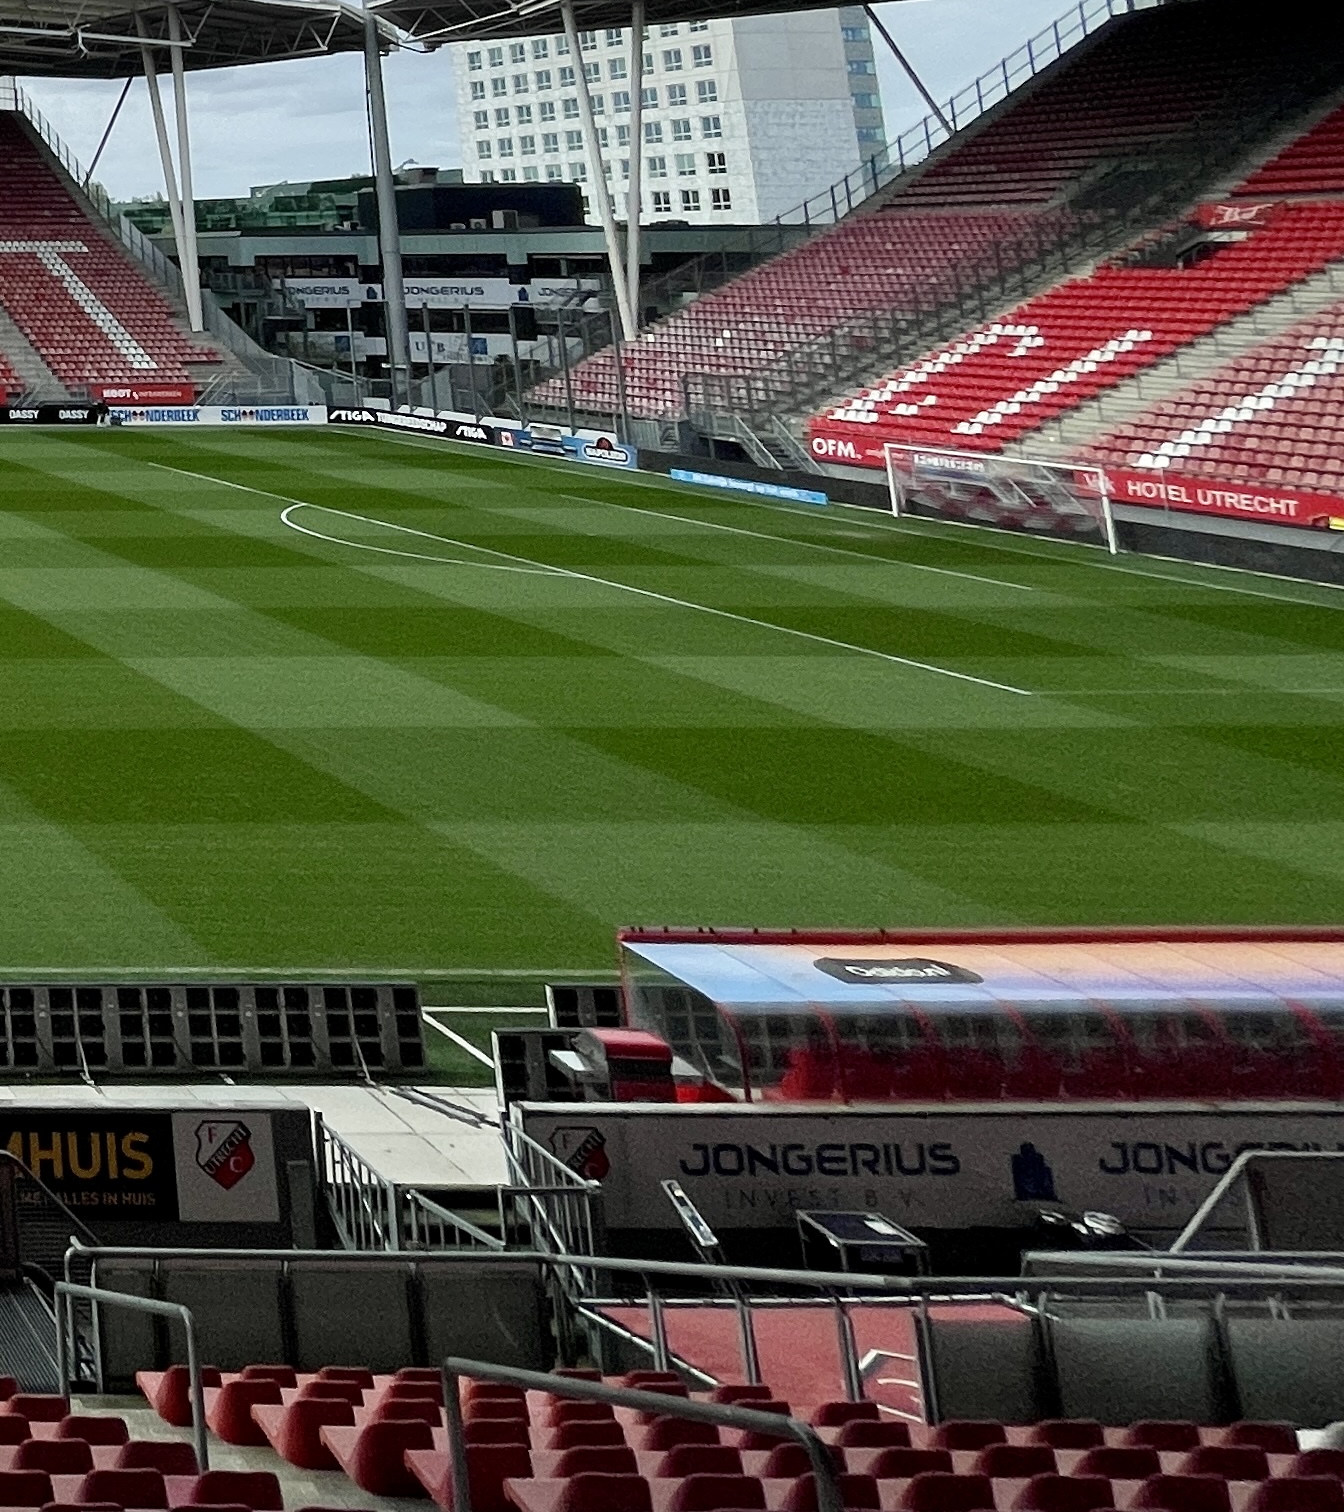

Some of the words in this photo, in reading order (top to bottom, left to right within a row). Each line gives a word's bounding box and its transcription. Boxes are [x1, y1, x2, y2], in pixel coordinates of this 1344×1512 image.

[286, 286, 350, 296] ONGERIUS
[329, 409, 375, 423] STIGA
[812, 437, 862, 460] OFM.
[1127, 479, 1194, 504] HOTEL
[1197, 488, 1299, 517] UTRECHT
[679, 1143, 961, 1176] JONGERIUS
